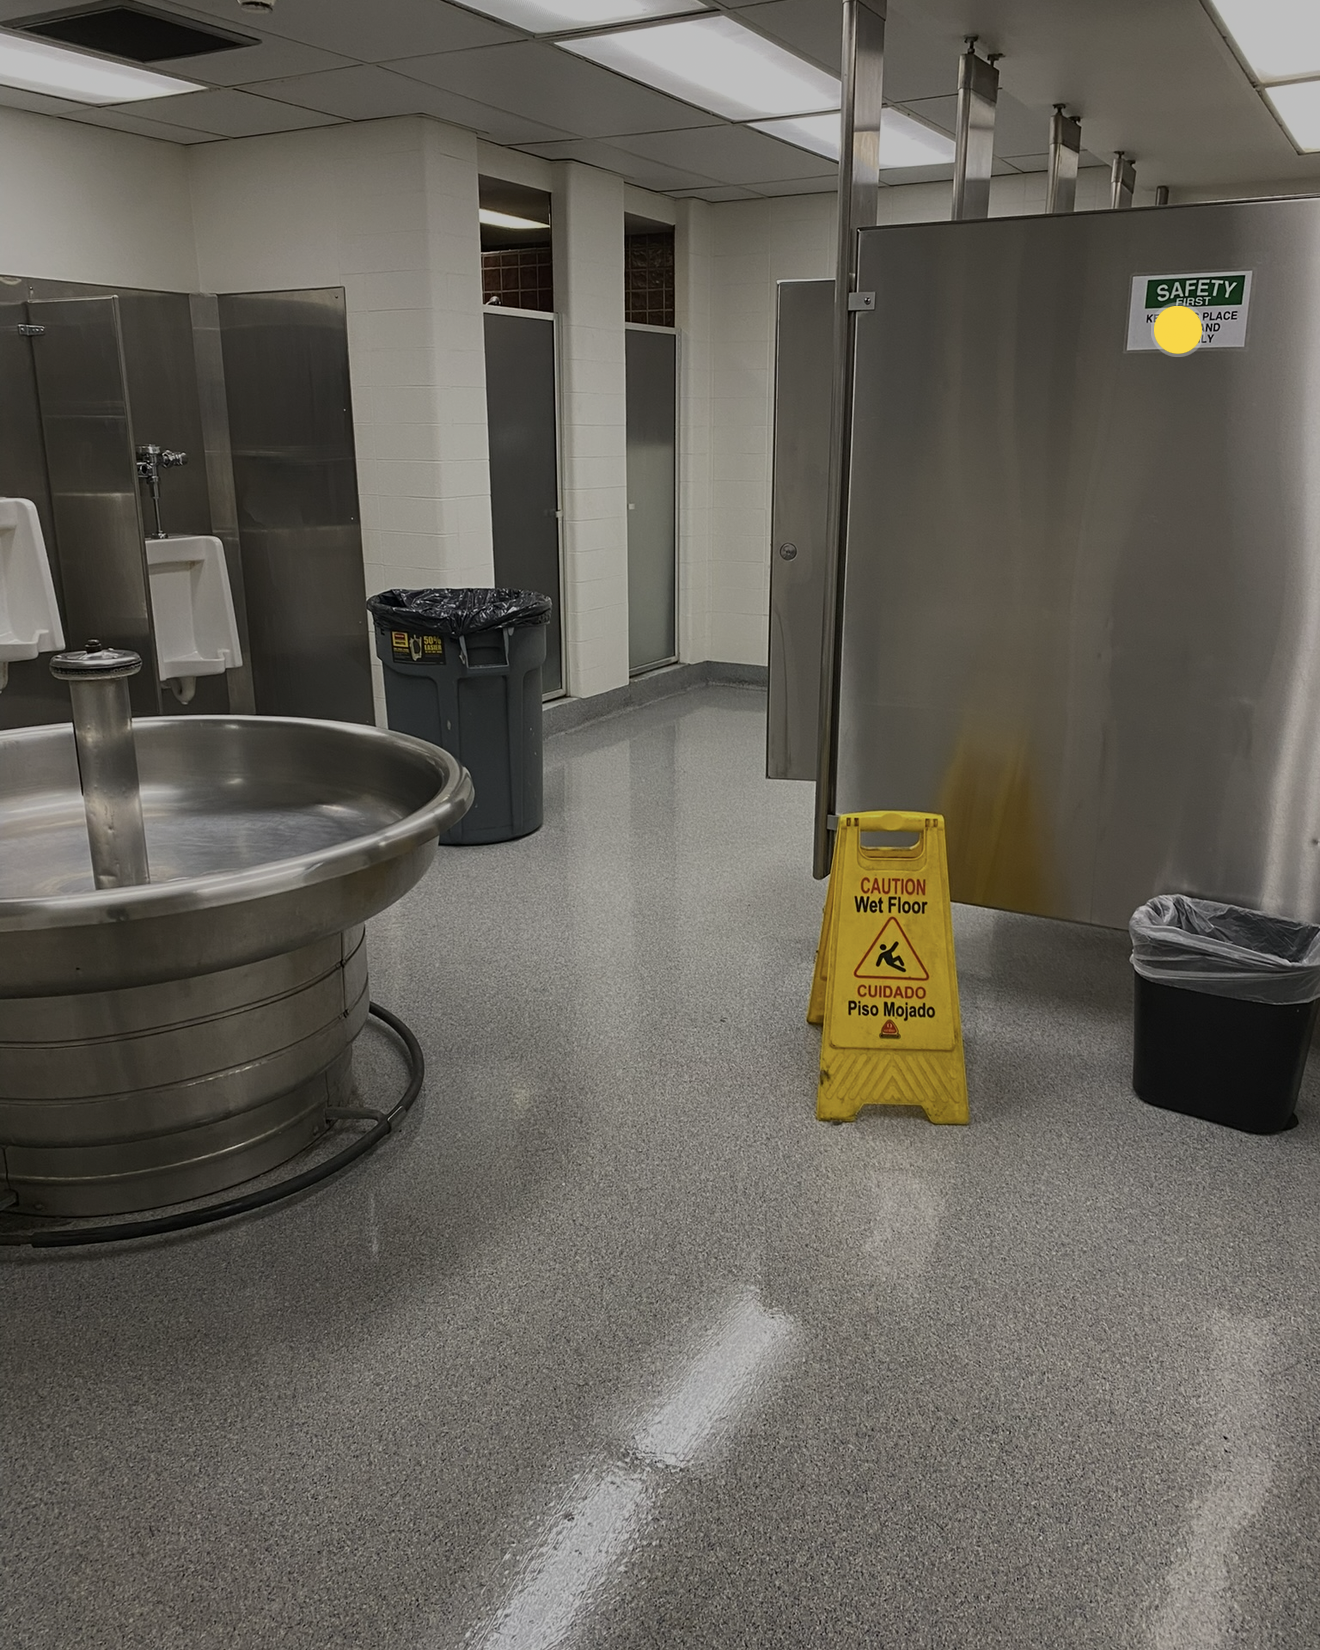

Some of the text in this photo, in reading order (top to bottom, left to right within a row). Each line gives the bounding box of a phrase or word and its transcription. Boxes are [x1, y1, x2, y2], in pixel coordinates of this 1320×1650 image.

[1156, 279, 1238, 302] SAFETY
[1175, 296, 1211, 307] FIRST
[1202, 310, 1238, 321] PLACE
[423, 635, 442, 645] 50%
[860, 876, 926, 896] CAUTION
[854, 895, 928, 914] Wet Floor
[857, 984, 926, 1000] CUIDADO
[847, 1000, 936, 1021] Piso Mojado
